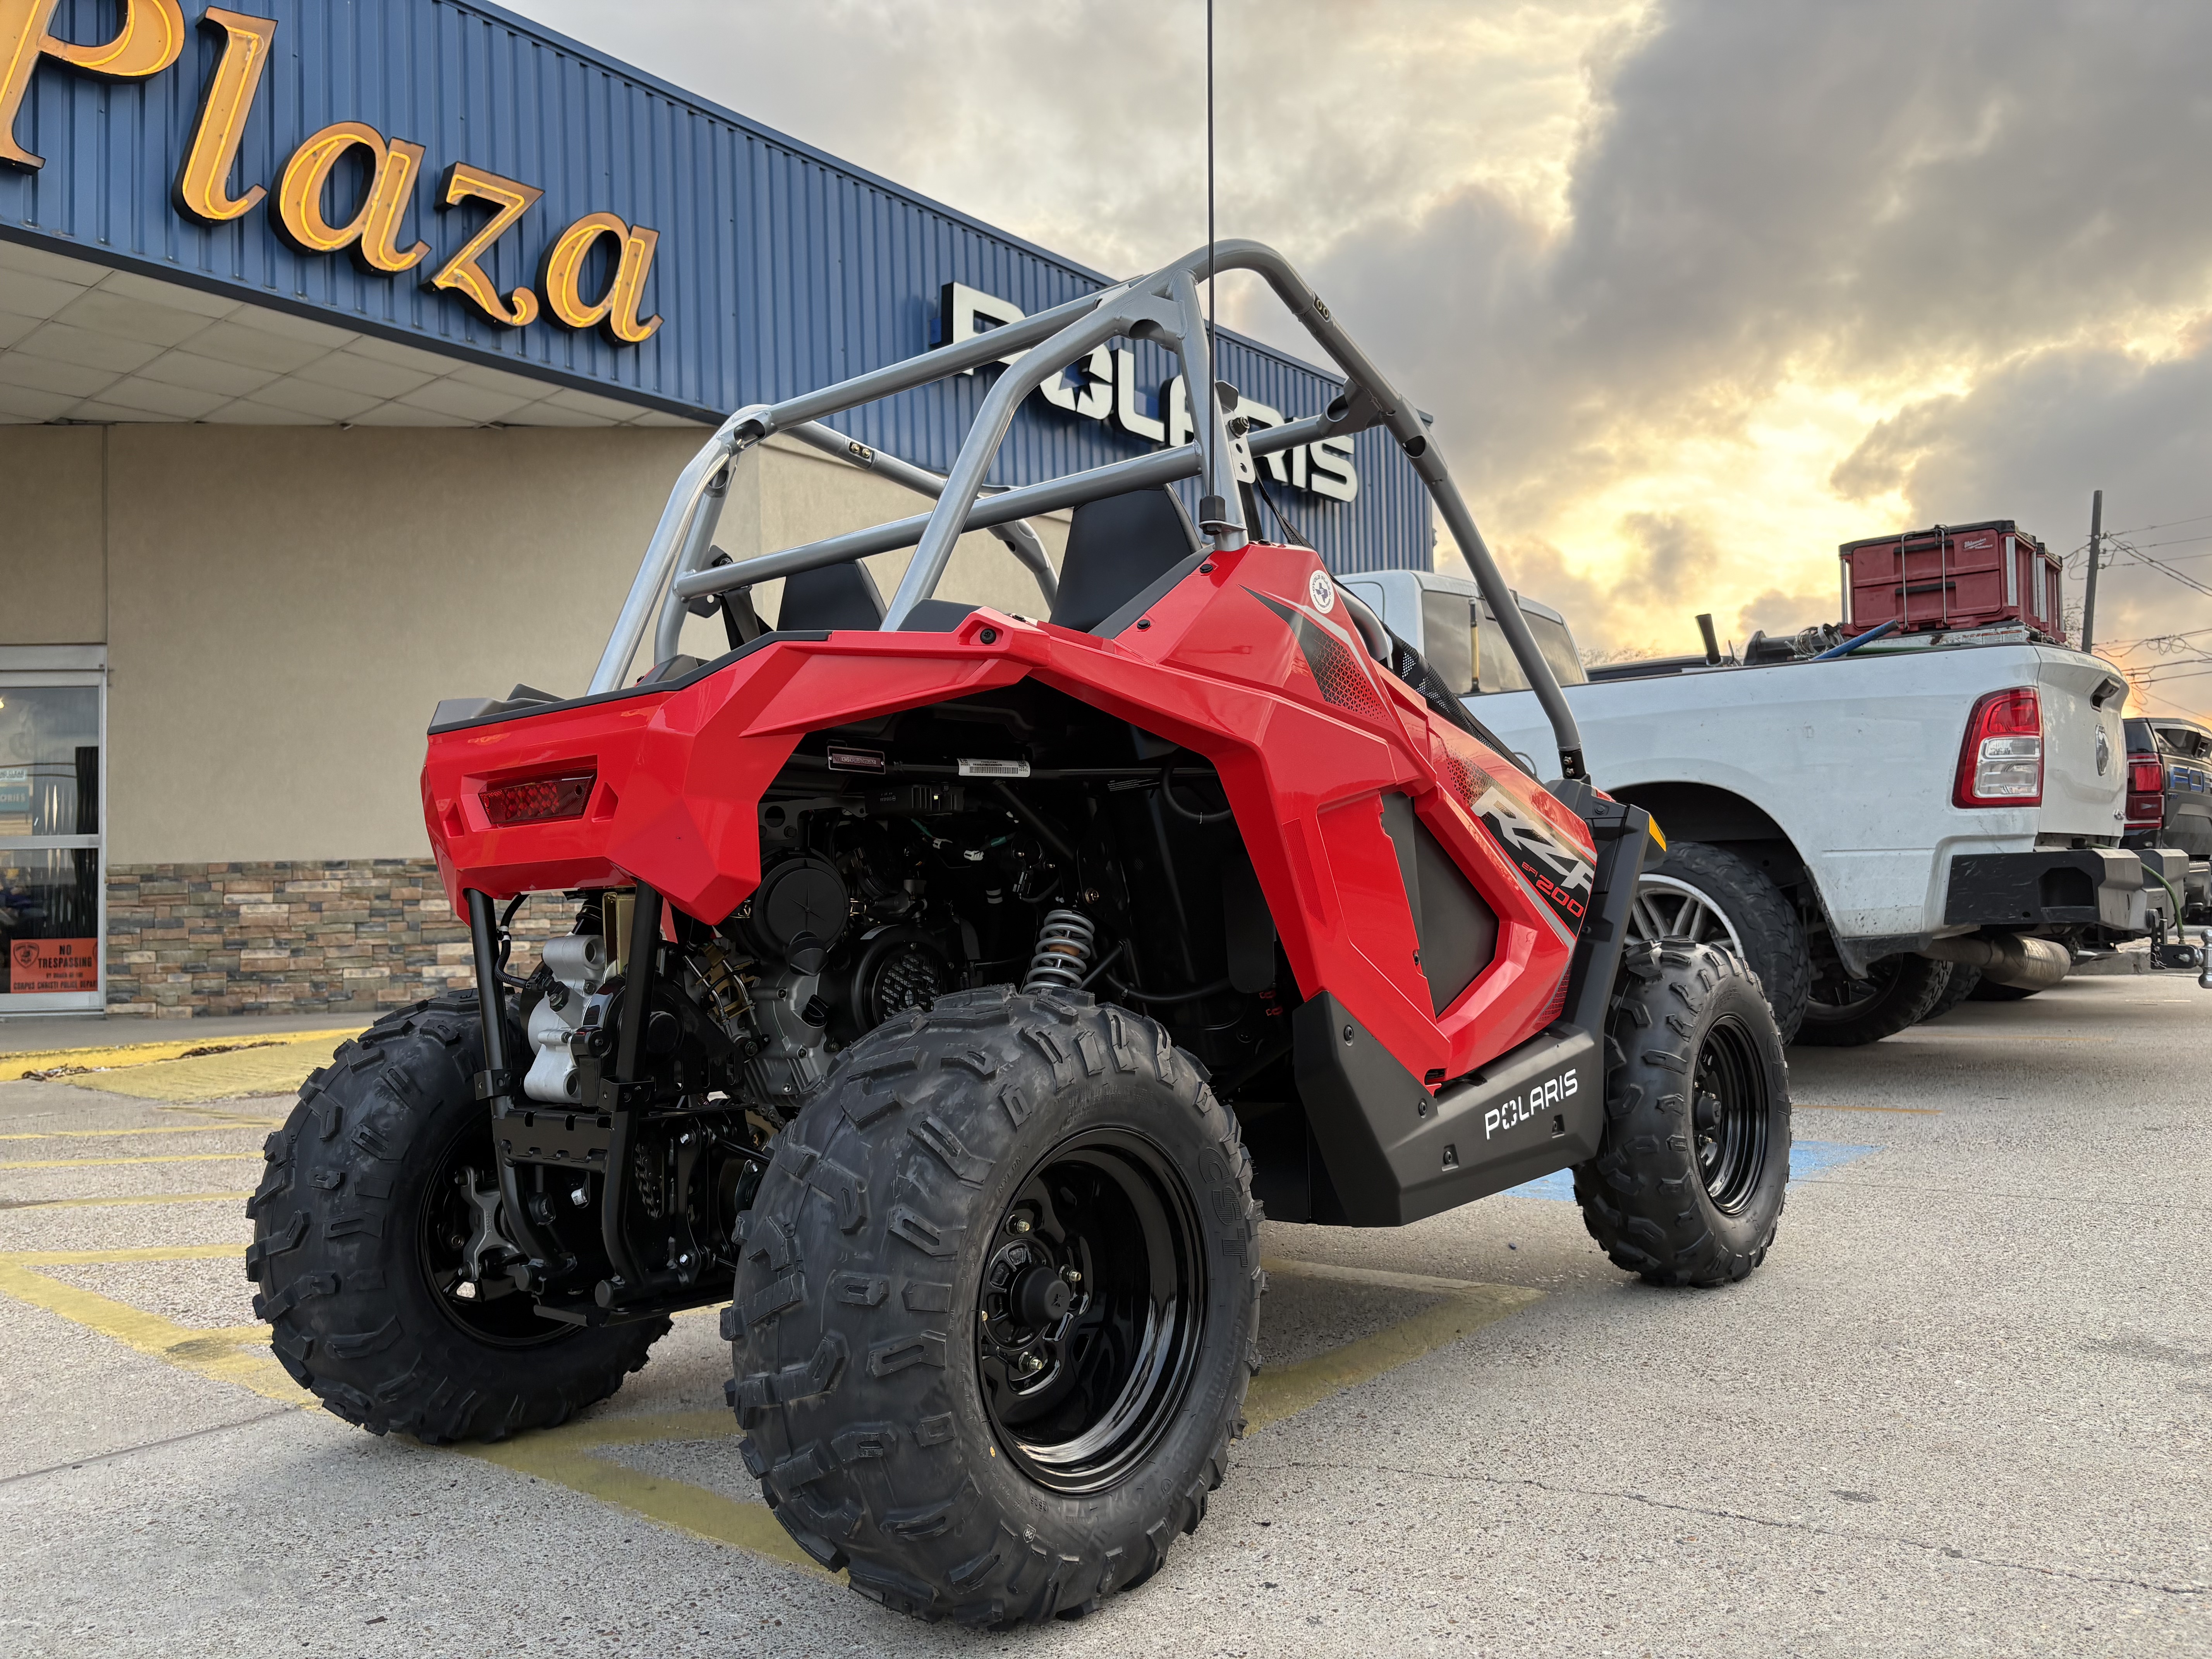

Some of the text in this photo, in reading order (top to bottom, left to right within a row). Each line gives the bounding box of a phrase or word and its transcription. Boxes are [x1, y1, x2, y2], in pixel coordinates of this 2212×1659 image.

[1522, 862, 1584, 917] EFI 200
[39, 957, 92, 968] TRESPASSING
[59, 945, 72, 955] NO
[1484, 1068, 1578, 1140] POLARIS
[1198, 1146, 1248, 1267] CST
